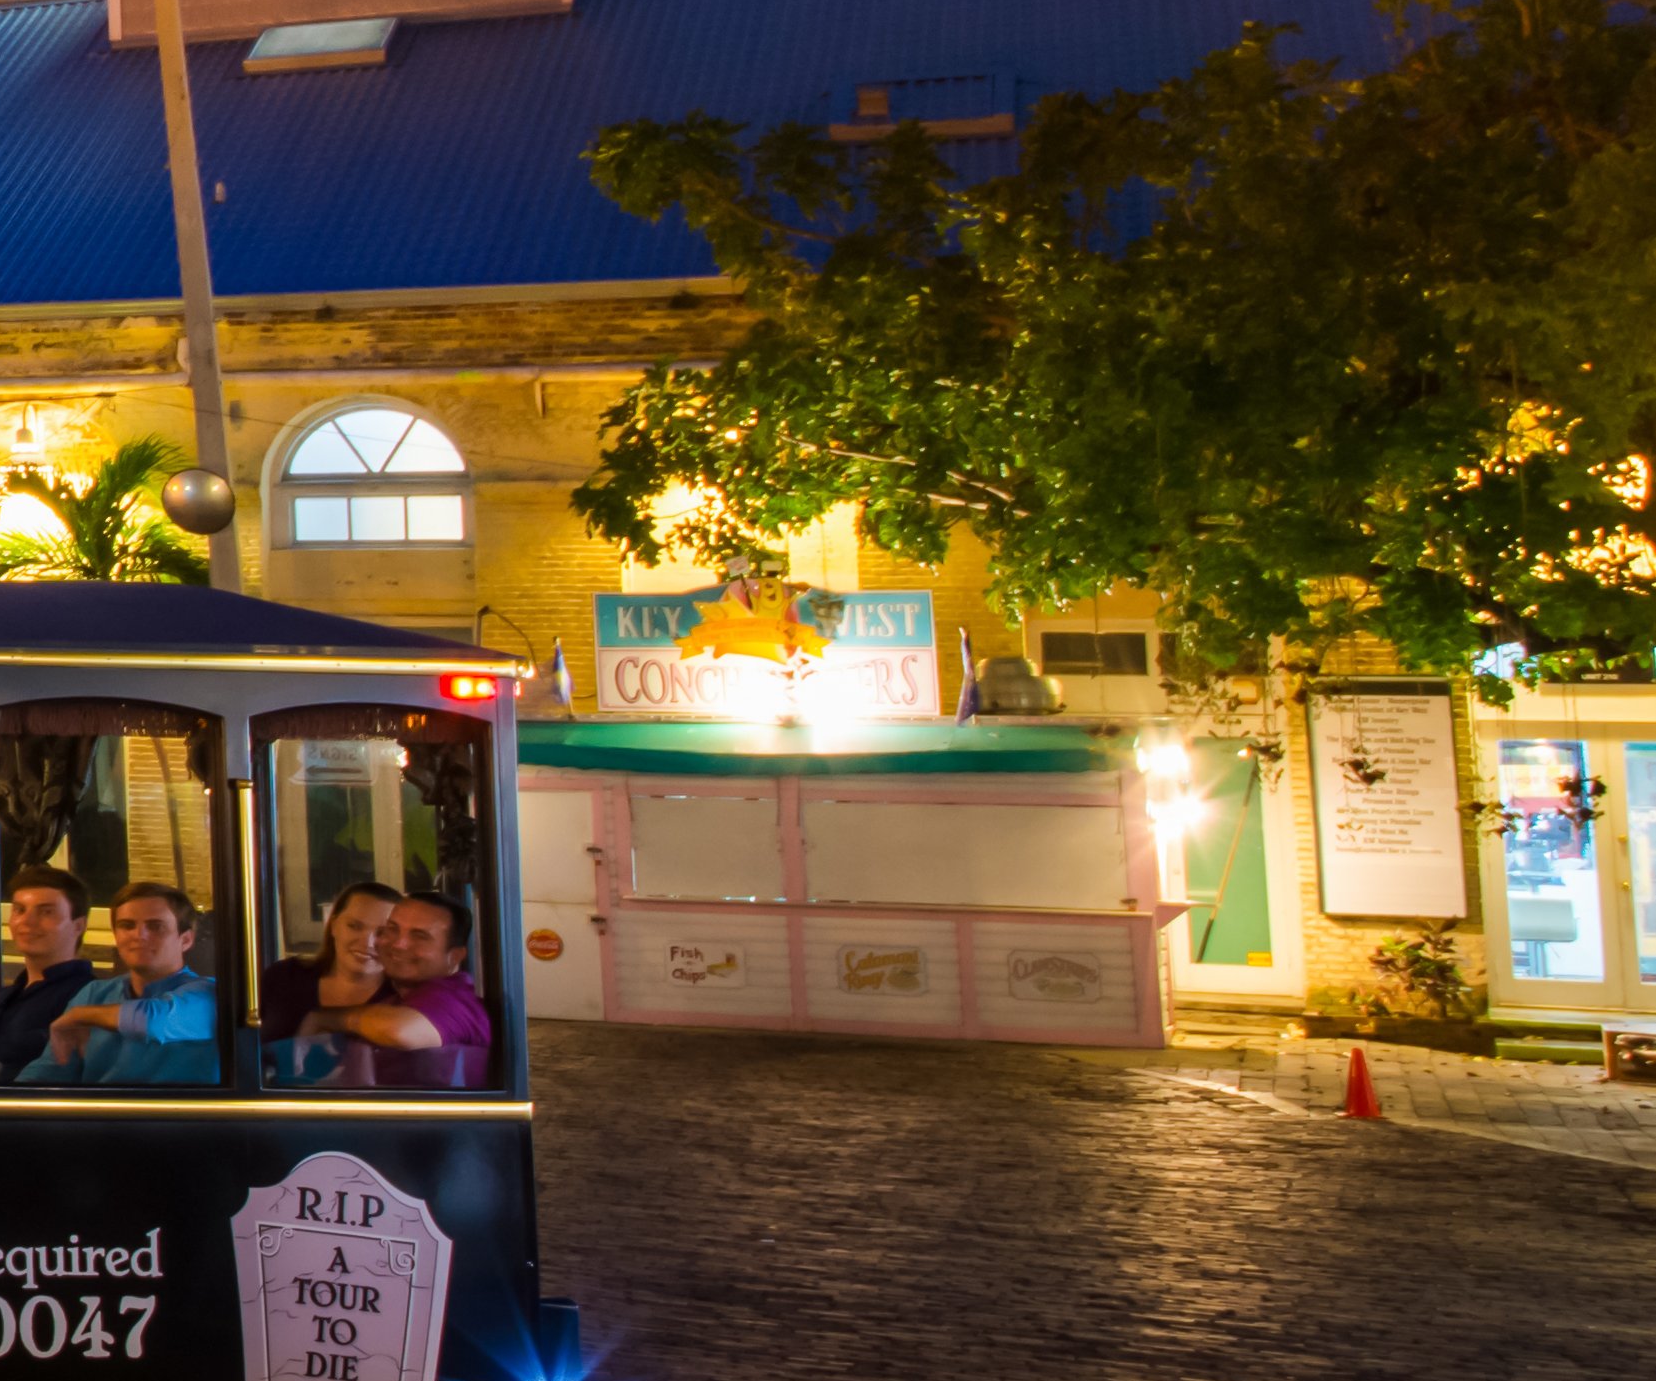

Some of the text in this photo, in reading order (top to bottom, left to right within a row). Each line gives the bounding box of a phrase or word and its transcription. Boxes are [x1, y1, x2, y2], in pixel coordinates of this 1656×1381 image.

[616, 604, 682, 639] KEY
[836, 603, 921, 638] WEST
[670, 945, 704, 963] Fish
[672, 968, 706, 984] Chips
[326, 1246, 351, 1276] A
[292, 1277, 381, 1315] TOUR
[312, 1315, 357, 1346] TO
